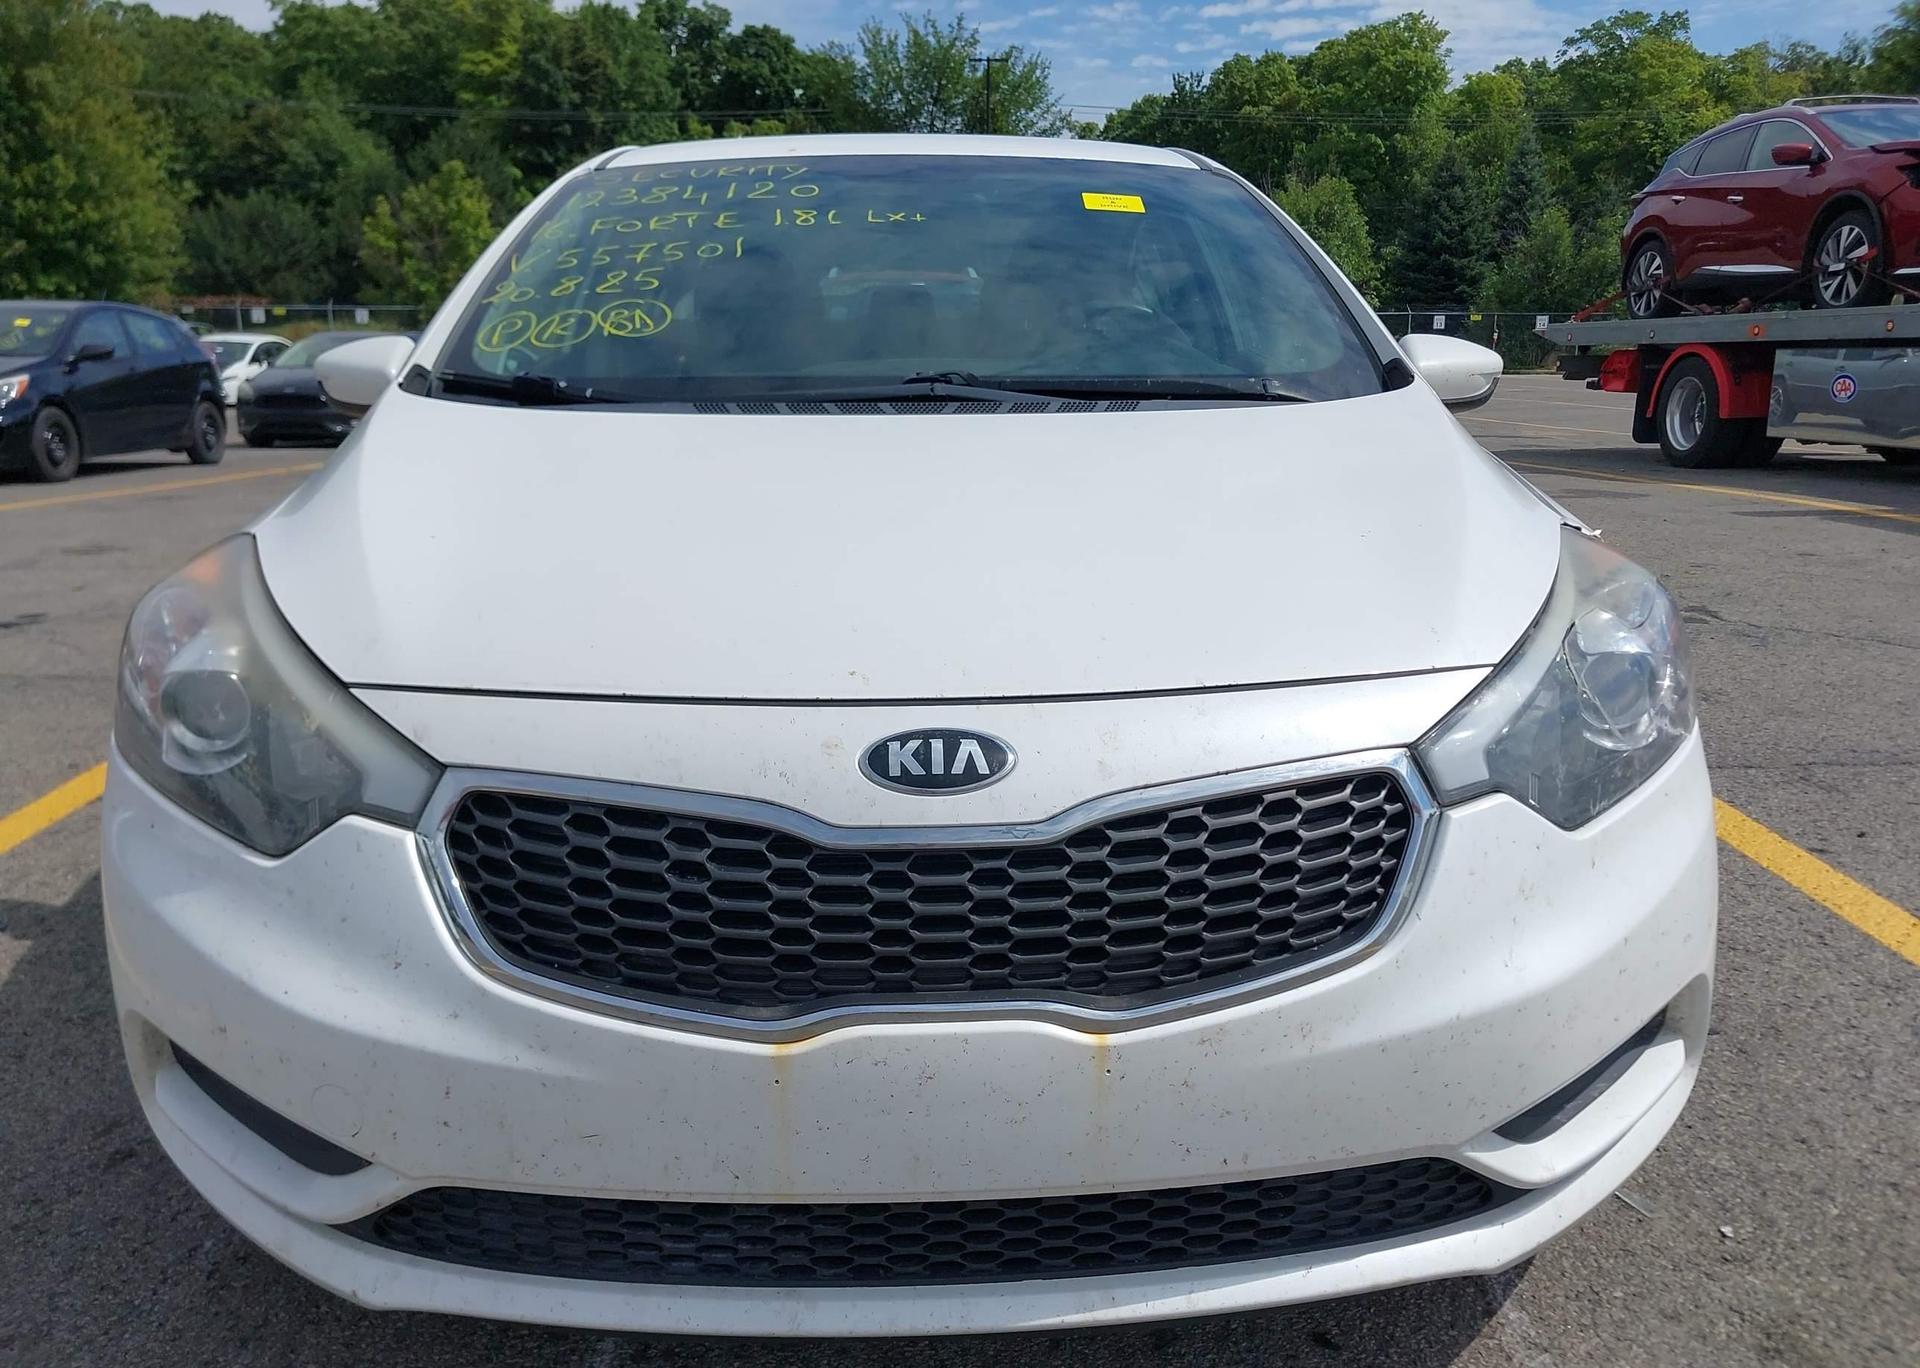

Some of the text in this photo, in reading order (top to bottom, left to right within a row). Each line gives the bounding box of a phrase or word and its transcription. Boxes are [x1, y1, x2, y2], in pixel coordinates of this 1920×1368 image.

[594, 163, 809, 184] SECURITY
[590, 212, 745, 236] FORTE
[868, 209, 927, 222] LX+
[886, 738, 991, 777] KIA
